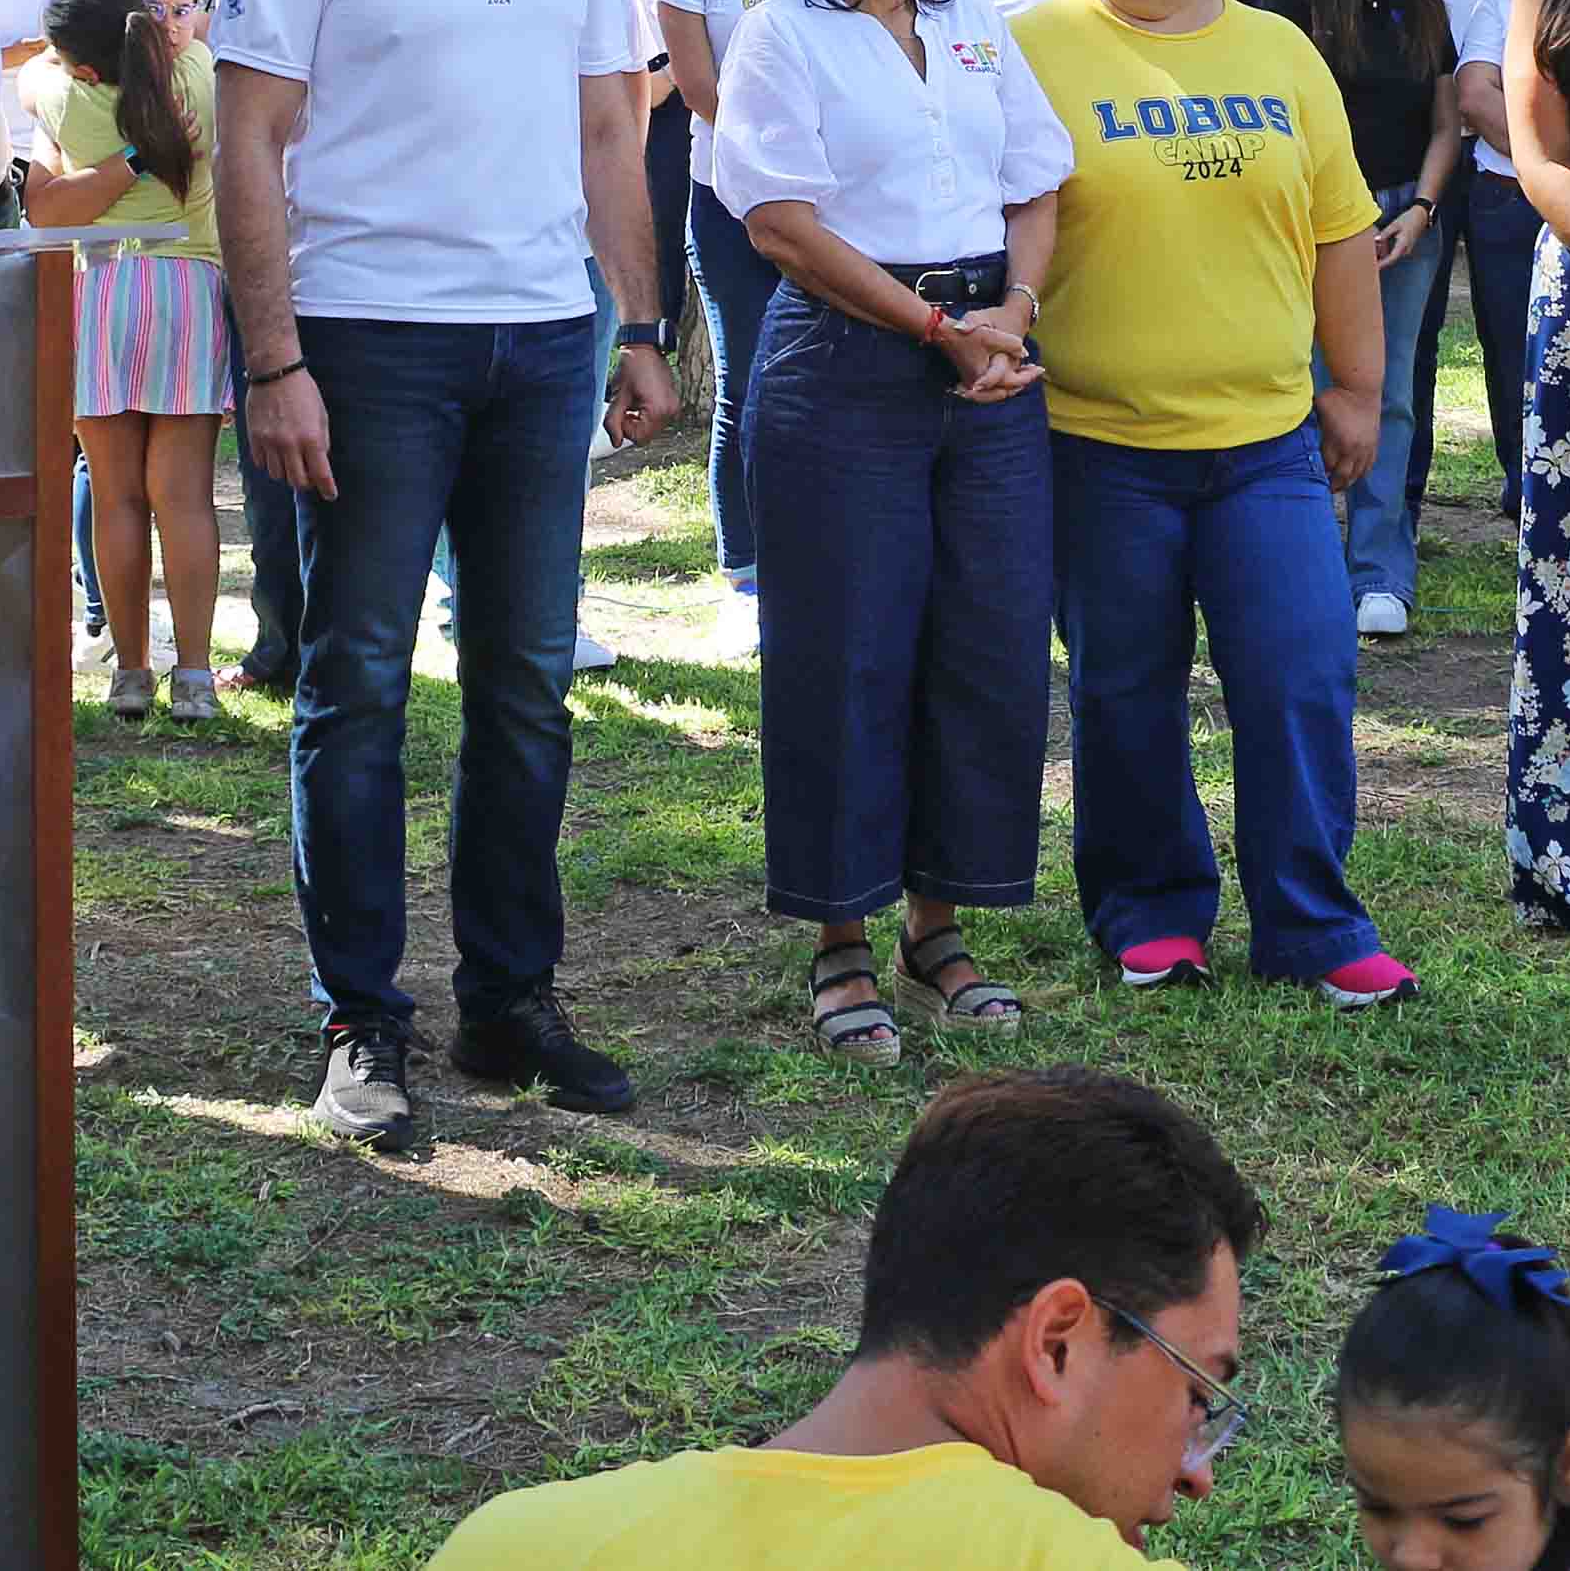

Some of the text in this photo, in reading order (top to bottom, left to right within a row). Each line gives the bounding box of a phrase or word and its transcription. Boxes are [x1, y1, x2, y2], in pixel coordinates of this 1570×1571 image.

[1092, 93, 1295, 143] LOBOS
[1153, 132, 1266, 167] CAMP
[1183, 158, 1243, 181] 2024
